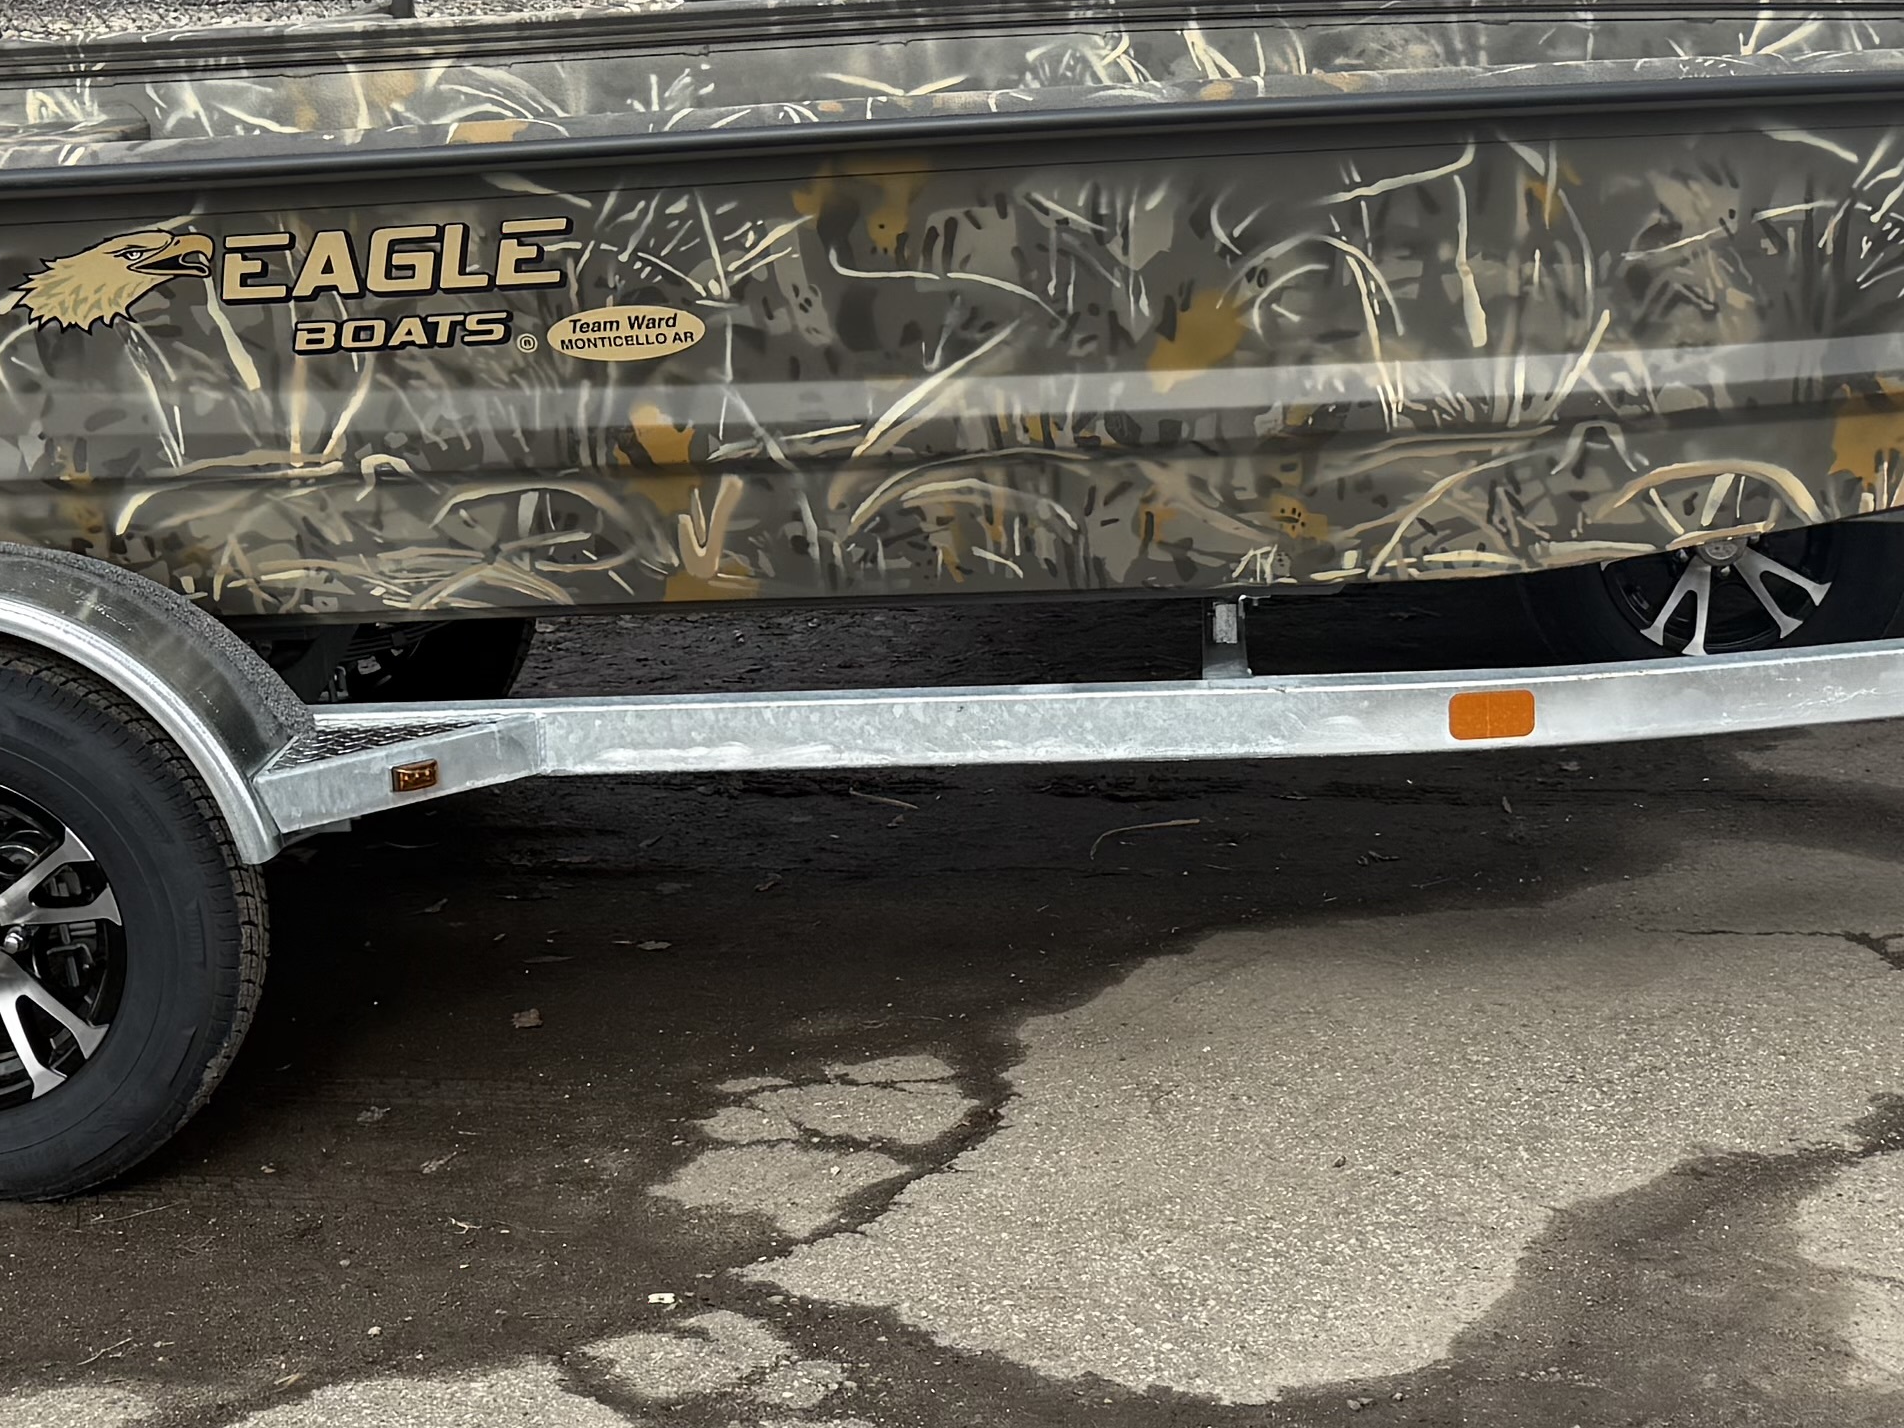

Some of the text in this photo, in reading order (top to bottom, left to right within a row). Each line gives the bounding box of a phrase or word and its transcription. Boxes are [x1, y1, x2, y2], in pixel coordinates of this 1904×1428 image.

[220, 216, 574, 305] EAGLE
[293, 310, 513, 355] BOATS
[569, 312, 678, 335] Team Ward
[560, 331, 694, 351] MONTICELLO AR
